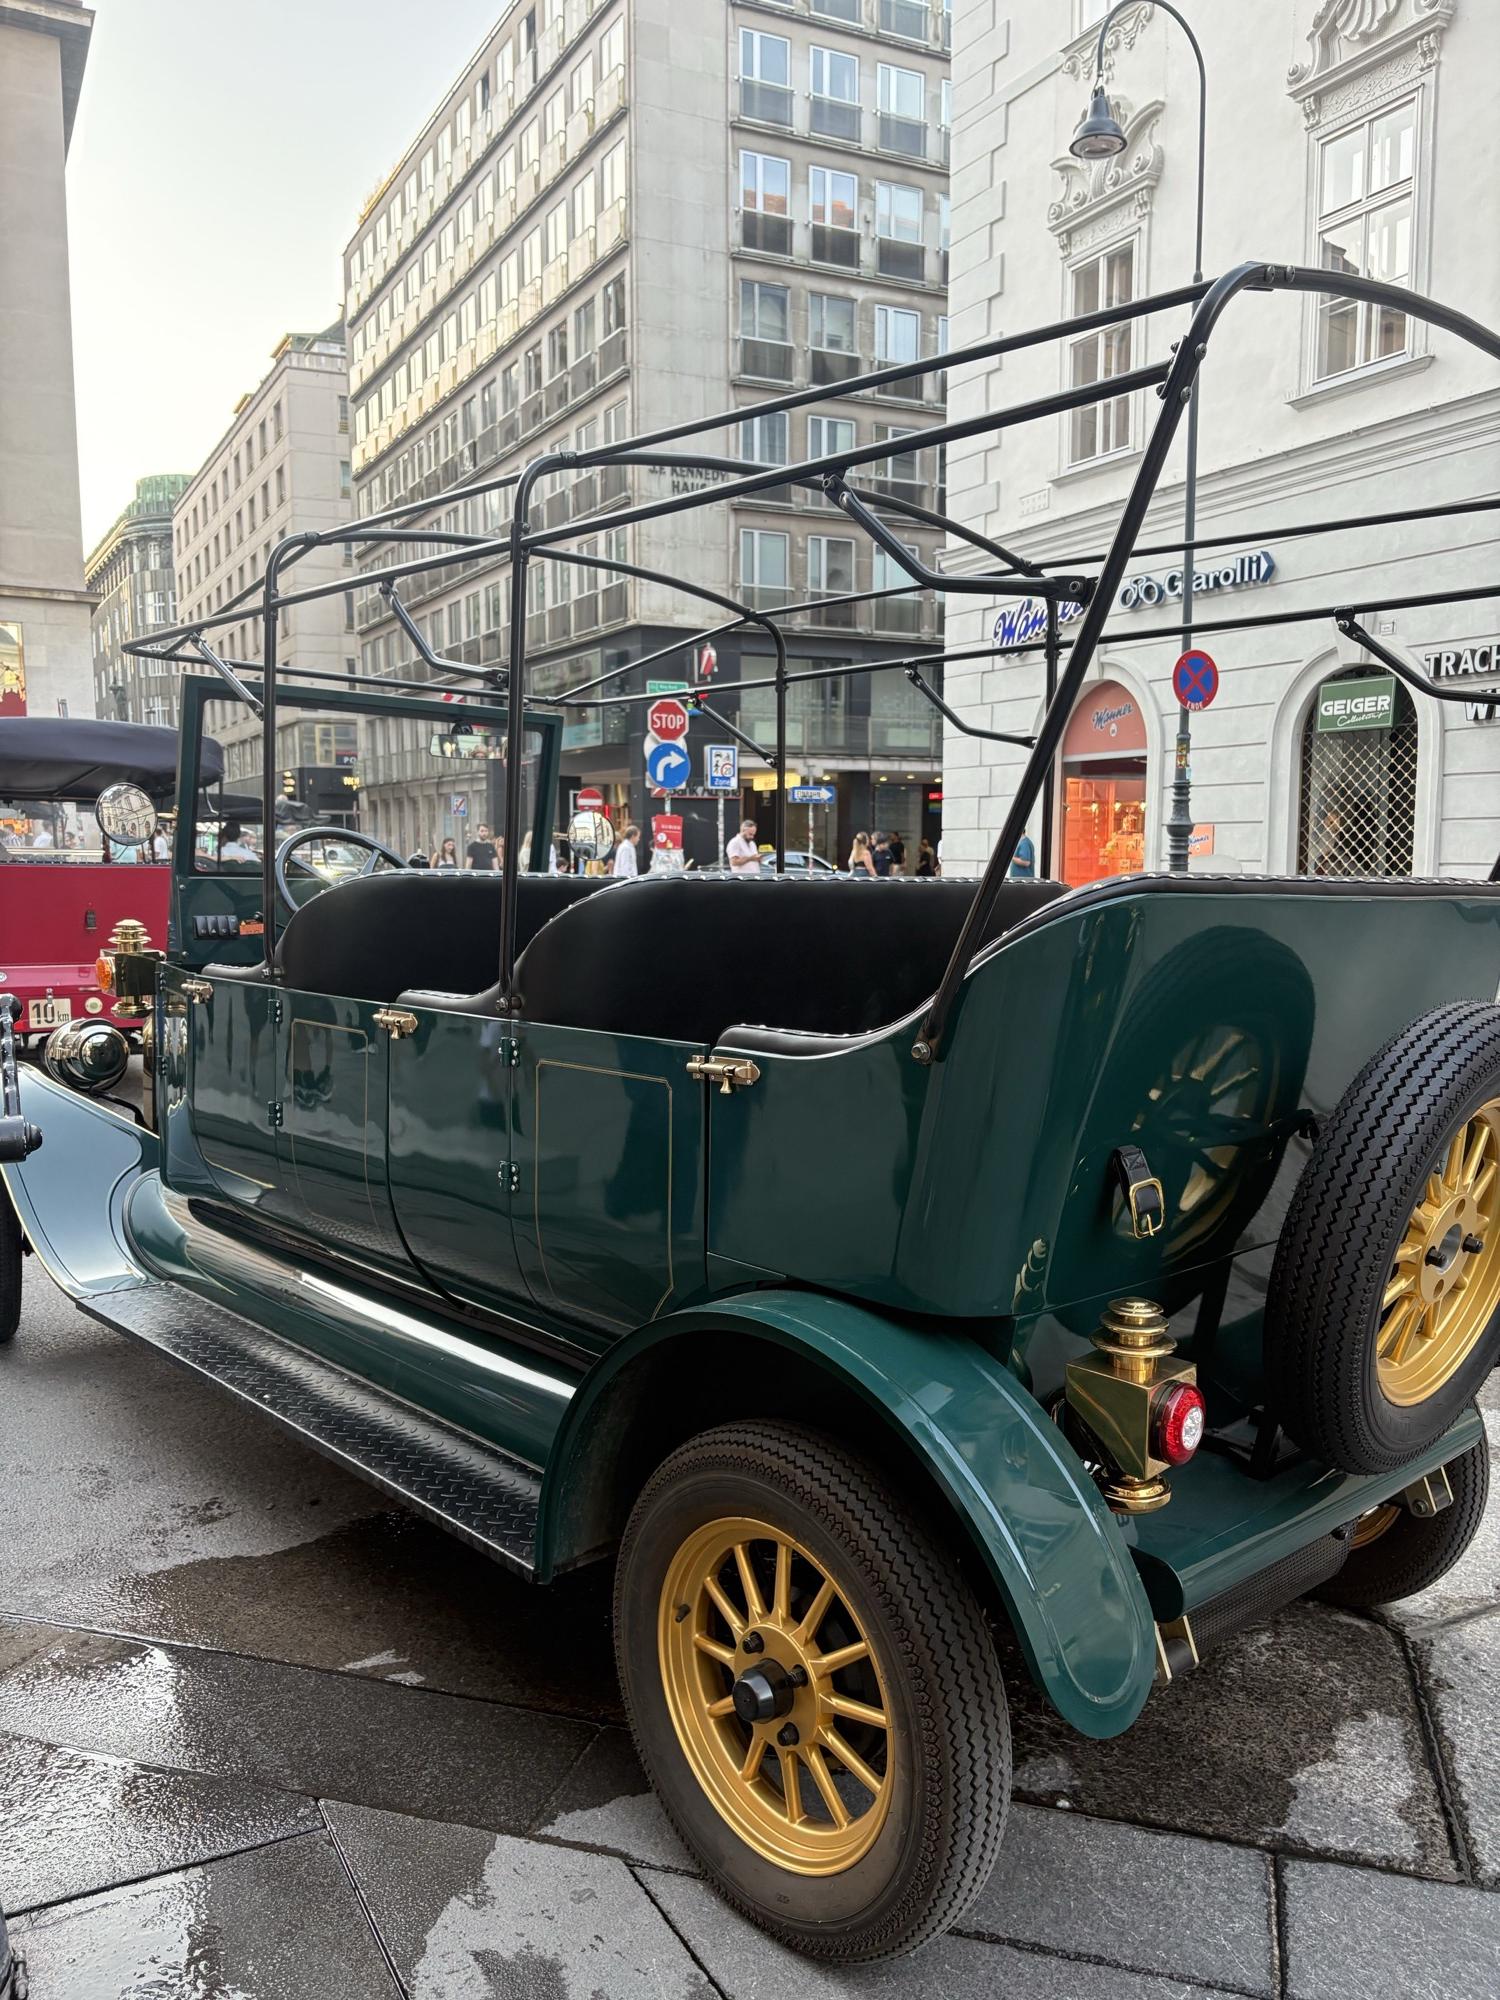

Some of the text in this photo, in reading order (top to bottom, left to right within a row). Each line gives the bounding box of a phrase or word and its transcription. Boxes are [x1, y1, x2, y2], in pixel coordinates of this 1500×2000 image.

[671, 466, 729, 481] KENNEDY
[1321, 695, 1391, 716] GEIGER
[652, 713, 684, 729] STOP
[32, 1003, 70, 1025] 10 km
